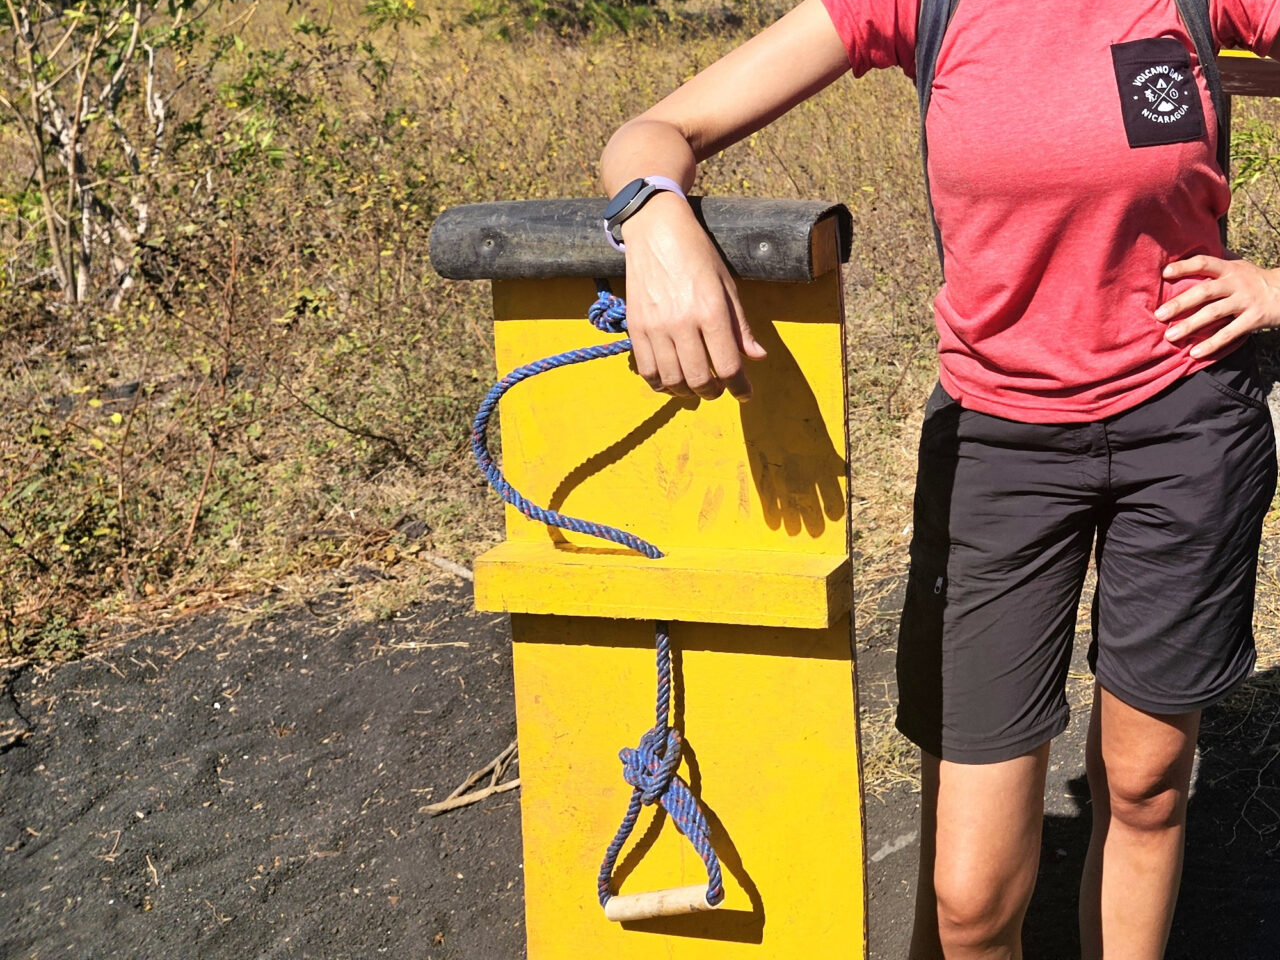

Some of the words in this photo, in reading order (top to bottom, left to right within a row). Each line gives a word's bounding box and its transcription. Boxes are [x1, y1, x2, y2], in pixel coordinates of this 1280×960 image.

[1132, 65, 1169, 87] VOLCANO
[1169, 68, 1184, 83] DAY
[1141, 104, 1189, 124] NICARAGUA
